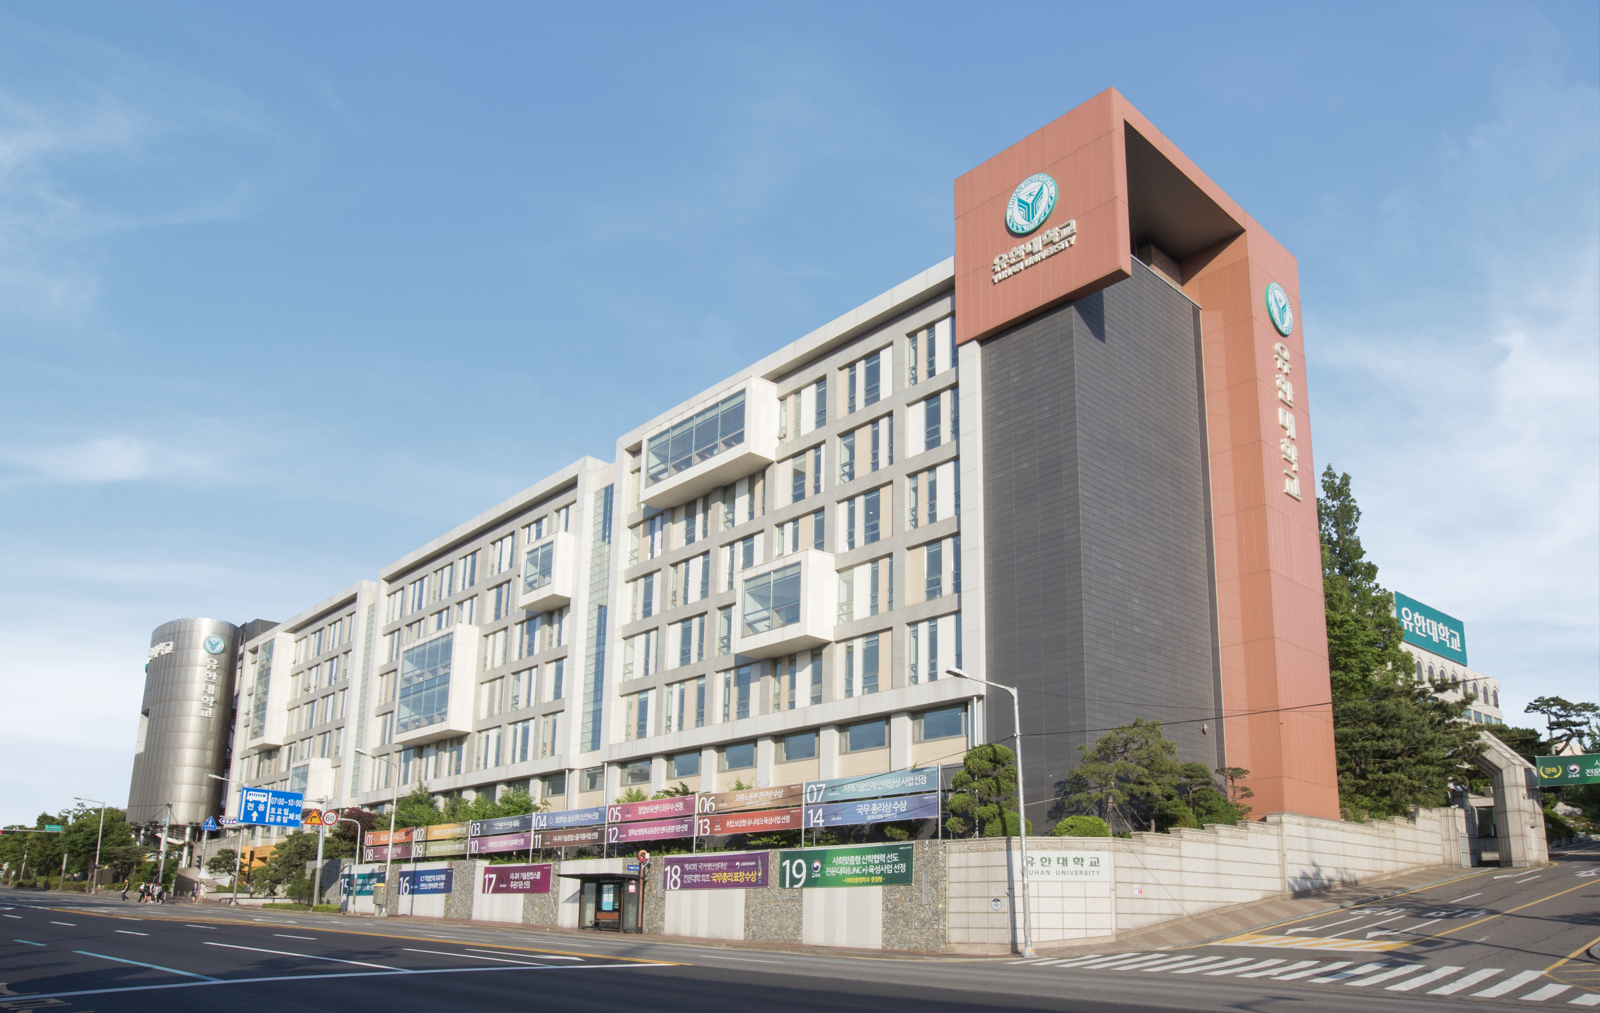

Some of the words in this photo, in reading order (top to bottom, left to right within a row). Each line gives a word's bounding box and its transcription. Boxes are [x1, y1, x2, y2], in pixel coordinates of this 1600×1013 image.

[992, 219, 1077, 273] 유한대학교
[992, 261, 1024, 284] YUHAN
[1024, 234, 1076, 268] UNIVERSITY
[1274, 342, 1302, 502] 유한대학교
[1401, 606, 1462, 653] 유한대학교
[199, 658, 219, 718] 유한대학교
[806, 784, 827, 804] 07
[269, 807, 289, 816] 토요일
[608, 806, 622, 822] 05
[699, 796, 716, 814] 06
[808, 808, 824, 828] 14
[892, 800, 907, 812] 수상
[470, 823, 480, 836] 03
[535, 816, 547, 830] 04
[698, 818, 710, 836] 13
[366, 834, 373, 846] 01
[416, 828, 424, 841] 02
[534, 835, 542, 848] 11
[608, 827, 618, 842] 12
[366, 849, 374, 862] 08
[414, 845, 423, 857] 09
[470, 840, 478, 854] 10
[886, 853, 899, 862] 선도
[1026, 856, 1100, 867] 유한대학교
[664, 865, 681, 890] 18
[782, 858, 806, 888] 19
[893, 862, 906, 874] 선정
[340, 878, 349, 896] 15
[400, 876, 410, 895] 16
[484, 874, 496, 894] 17
